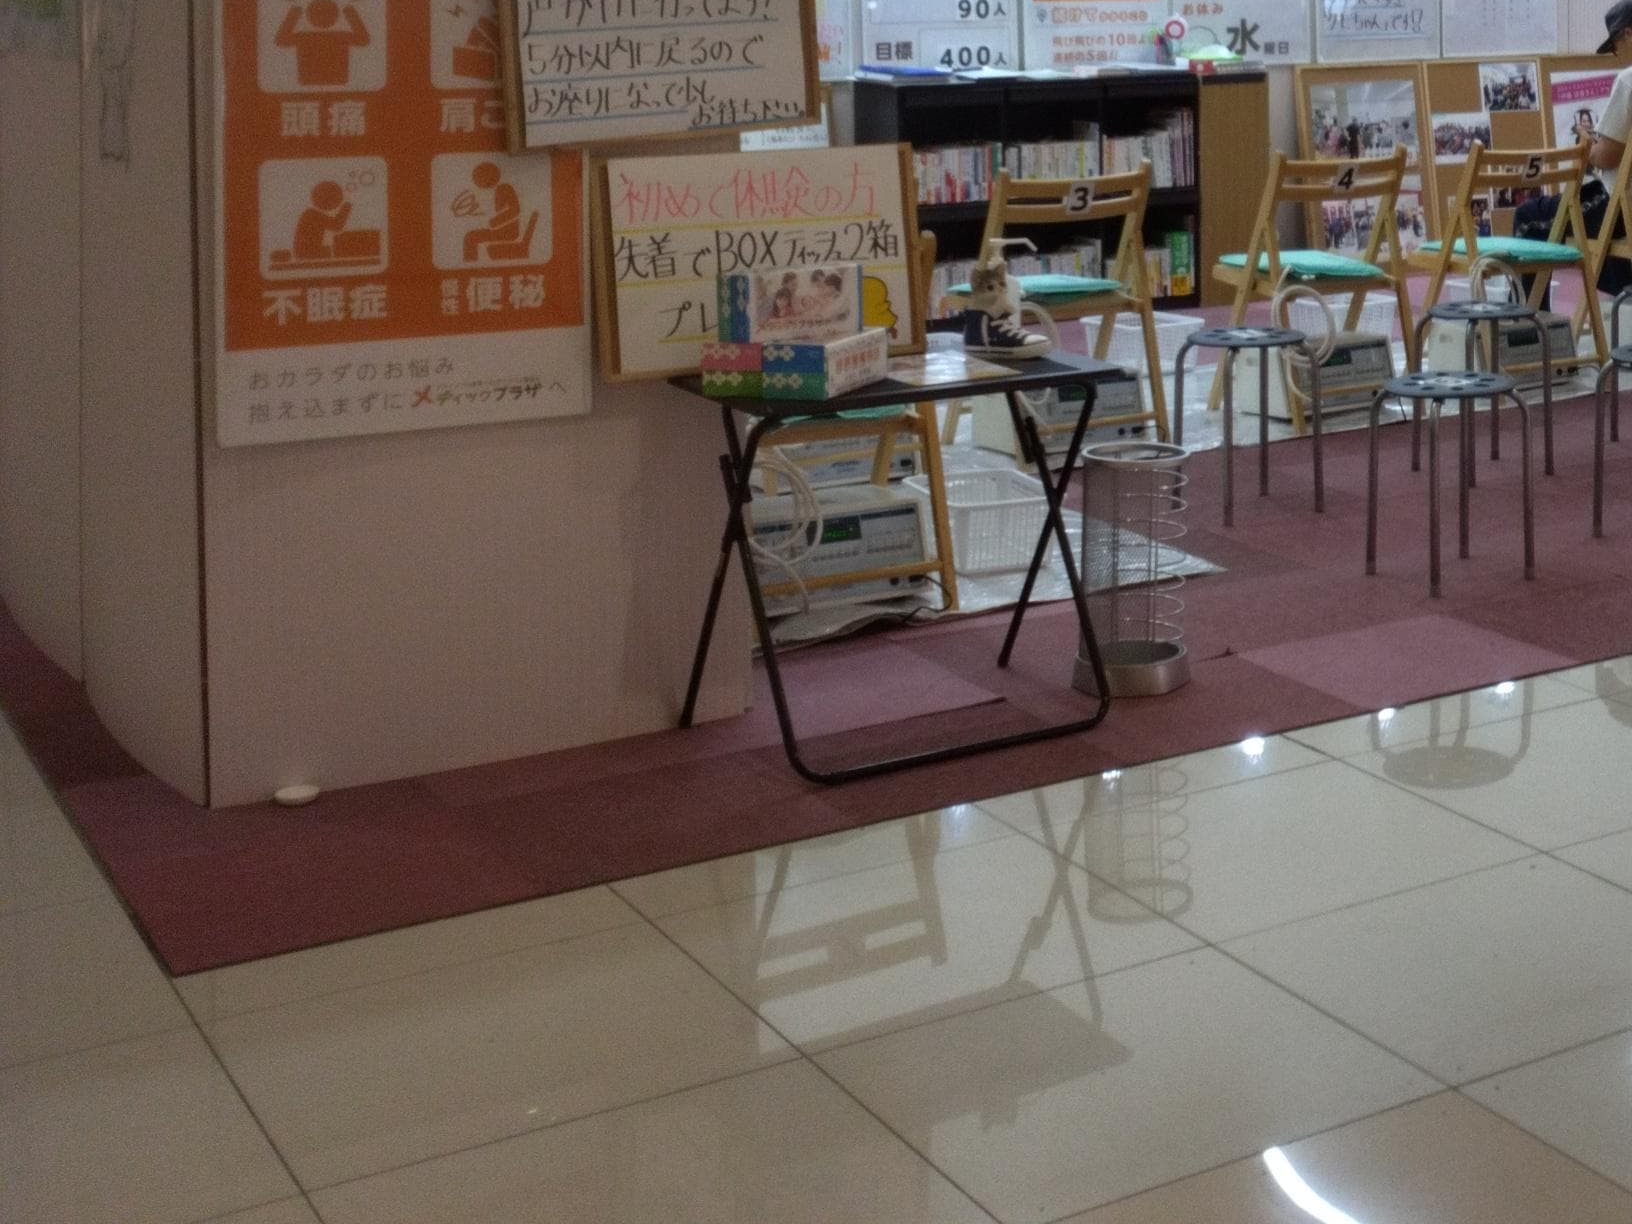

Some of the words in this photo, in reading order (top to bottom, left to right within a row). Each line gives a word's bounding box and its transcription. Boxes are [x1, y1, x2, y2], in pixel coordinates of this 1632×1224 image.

[1182, 2, 1224, 17] お休み
[527, 33, 765, 75] 5分以内に戻るので
[875, 41, 914, 61] 目標
[281, 101, 367, 137] 頭痛
[439, 97, 503, 134] 肩こ
[1337, 167, 1355, 190] 4
[1525, 157, 1543, 179] 5
[1070, 186, 1089, 211] 3
[262, 283, 389, 327] 不眠症
[466, 273, 547, 314] 便秘
[658, 299, 718, 338] プレ
